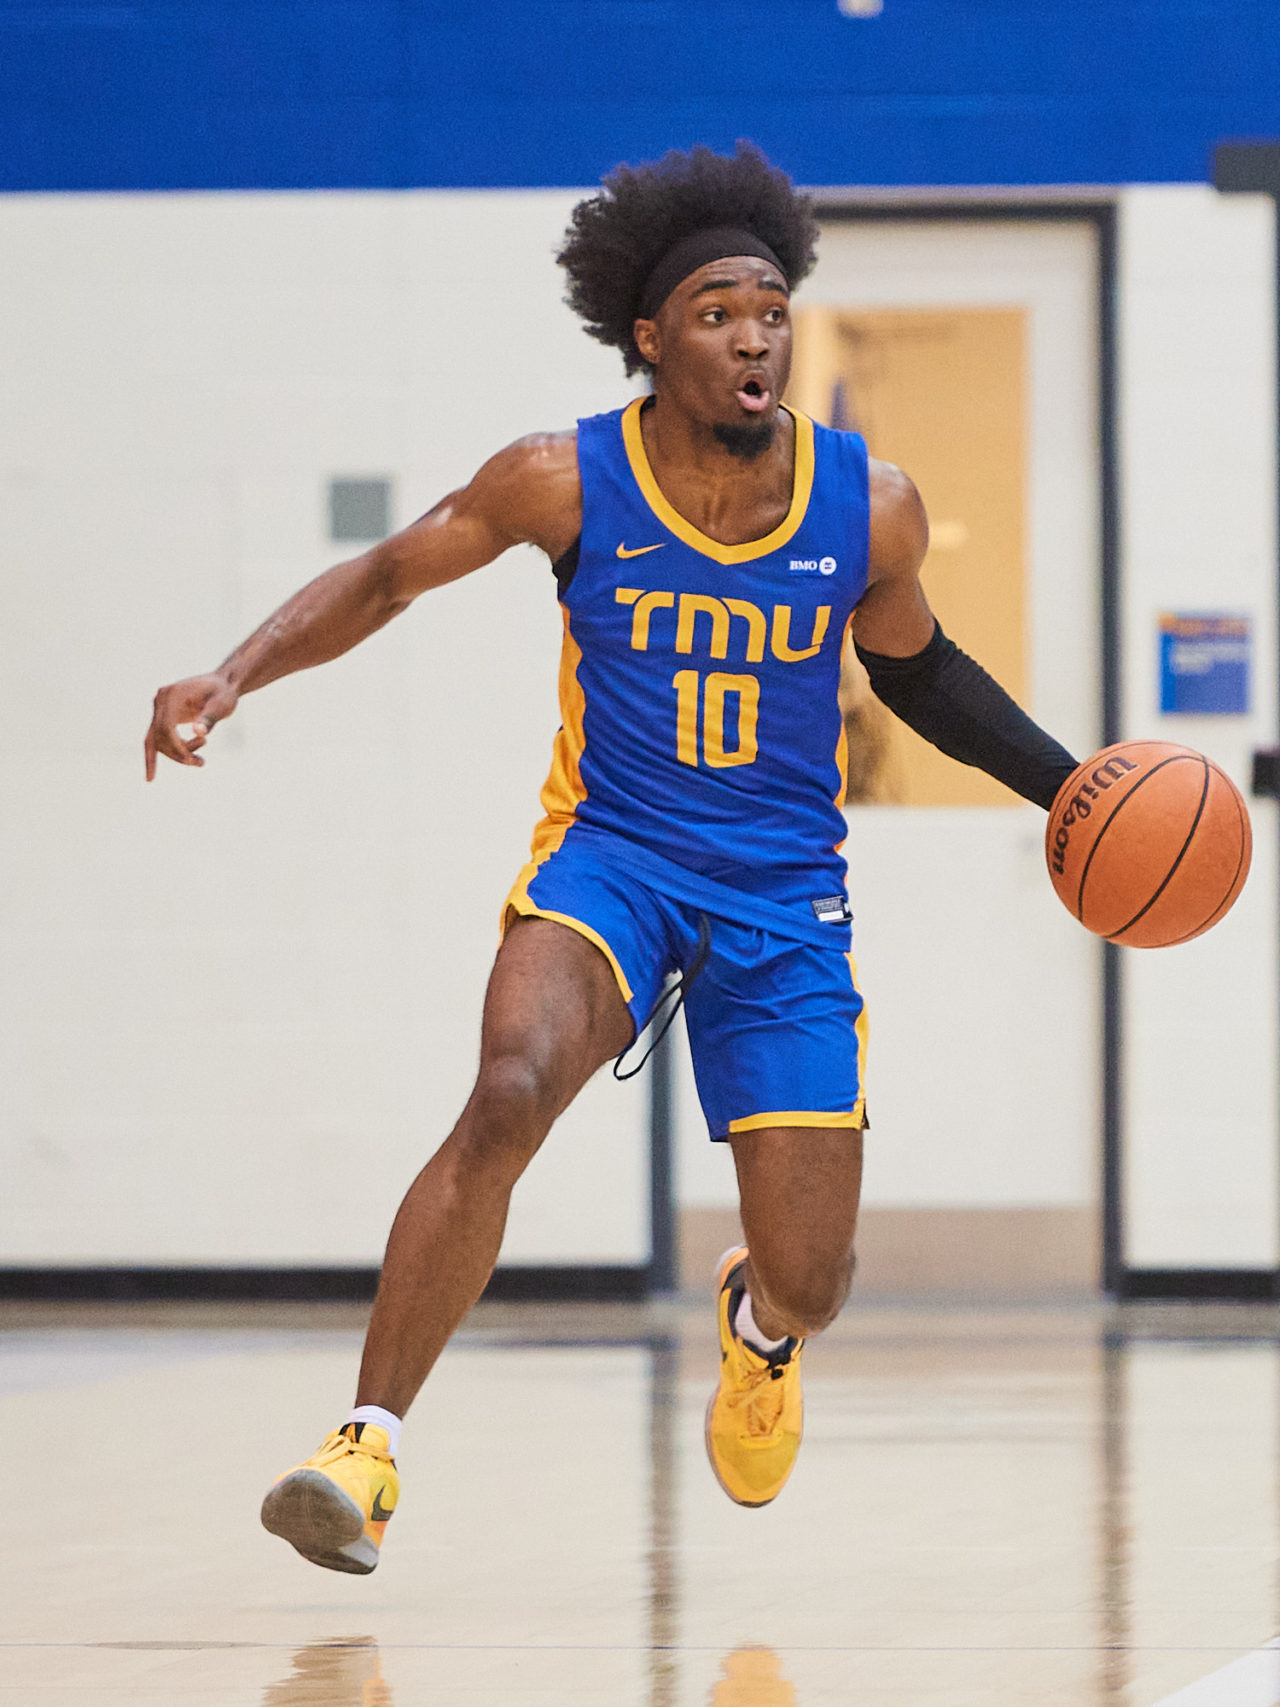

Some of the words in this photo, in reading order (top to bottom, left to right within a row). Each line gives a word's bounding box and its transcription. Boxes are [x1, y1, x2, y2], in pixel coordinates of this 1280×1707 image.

[789, 560, 818, 571] BMO
[615, 587, 832, 663] TMU
[672, 669, 761, 768] 10
[1052, 756, 1139, 875] Wilson
